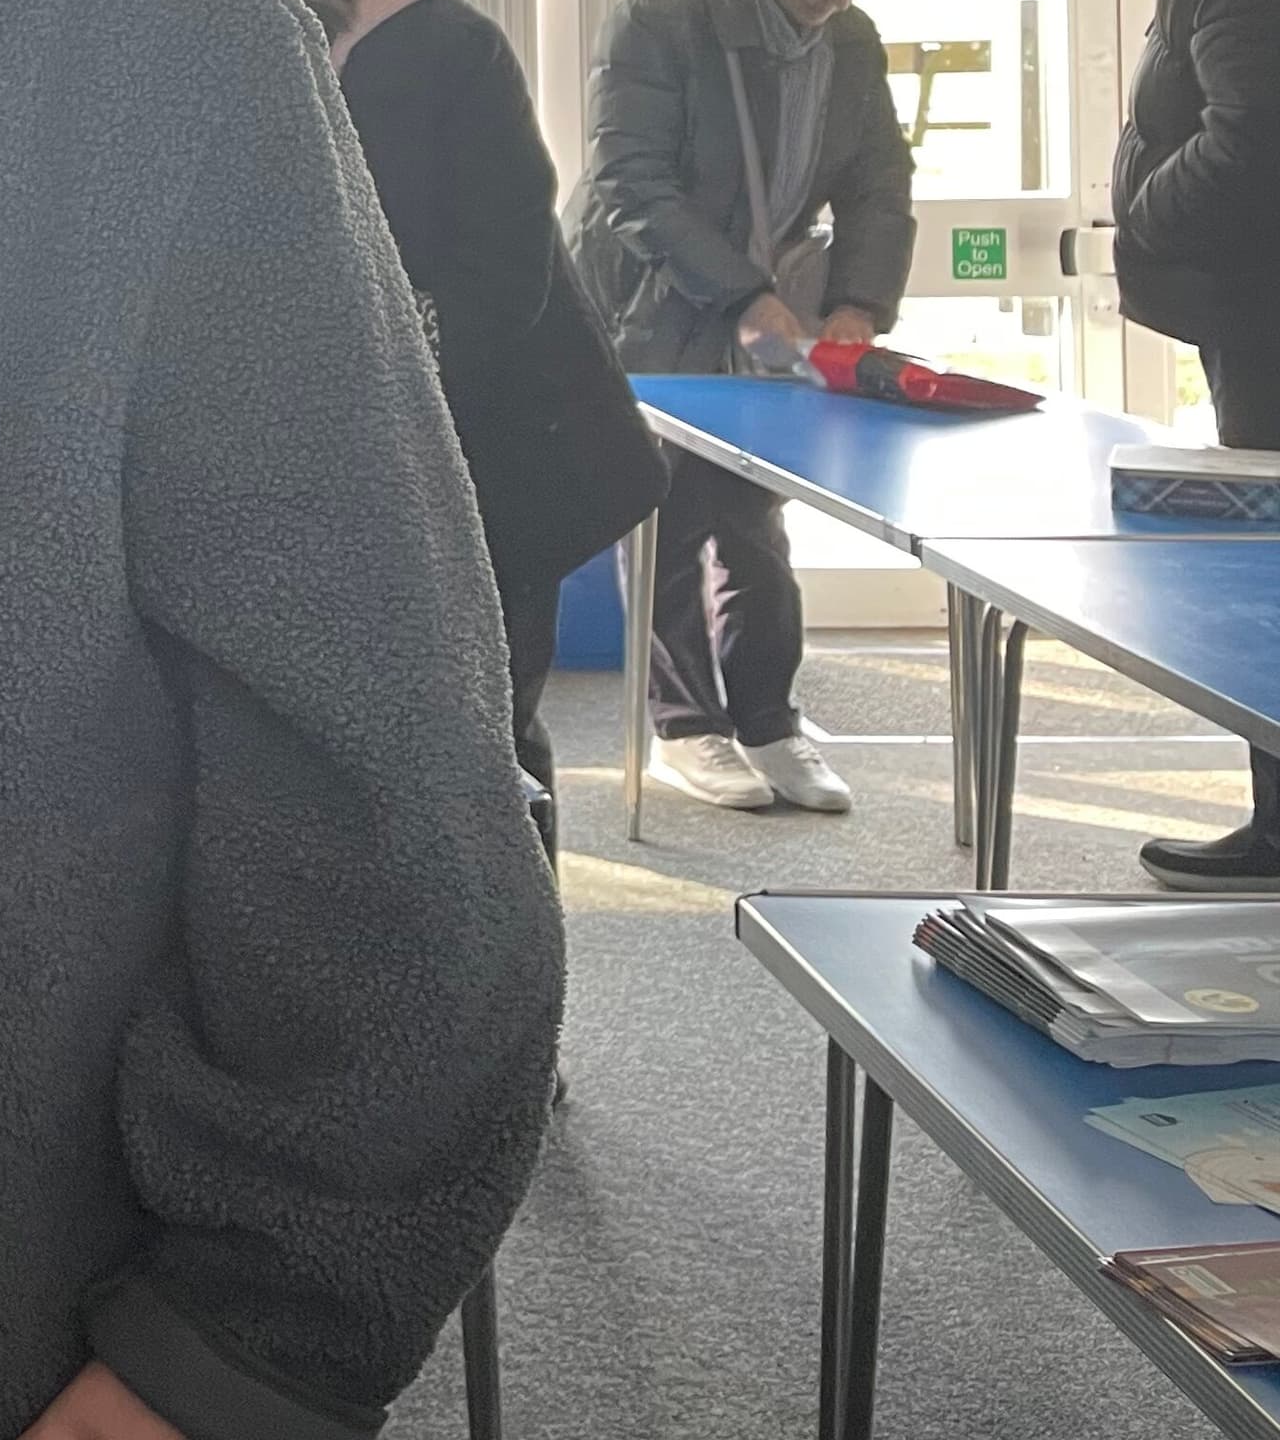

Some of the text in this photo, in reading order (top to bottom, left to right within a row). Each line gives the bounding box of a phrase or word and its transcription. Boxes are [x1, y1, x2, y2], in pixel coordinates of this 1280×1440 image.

[958, 231, 1000, 246] Push
[972, 247, 988, 261] to
[957, 262, 1003, 278] Open
